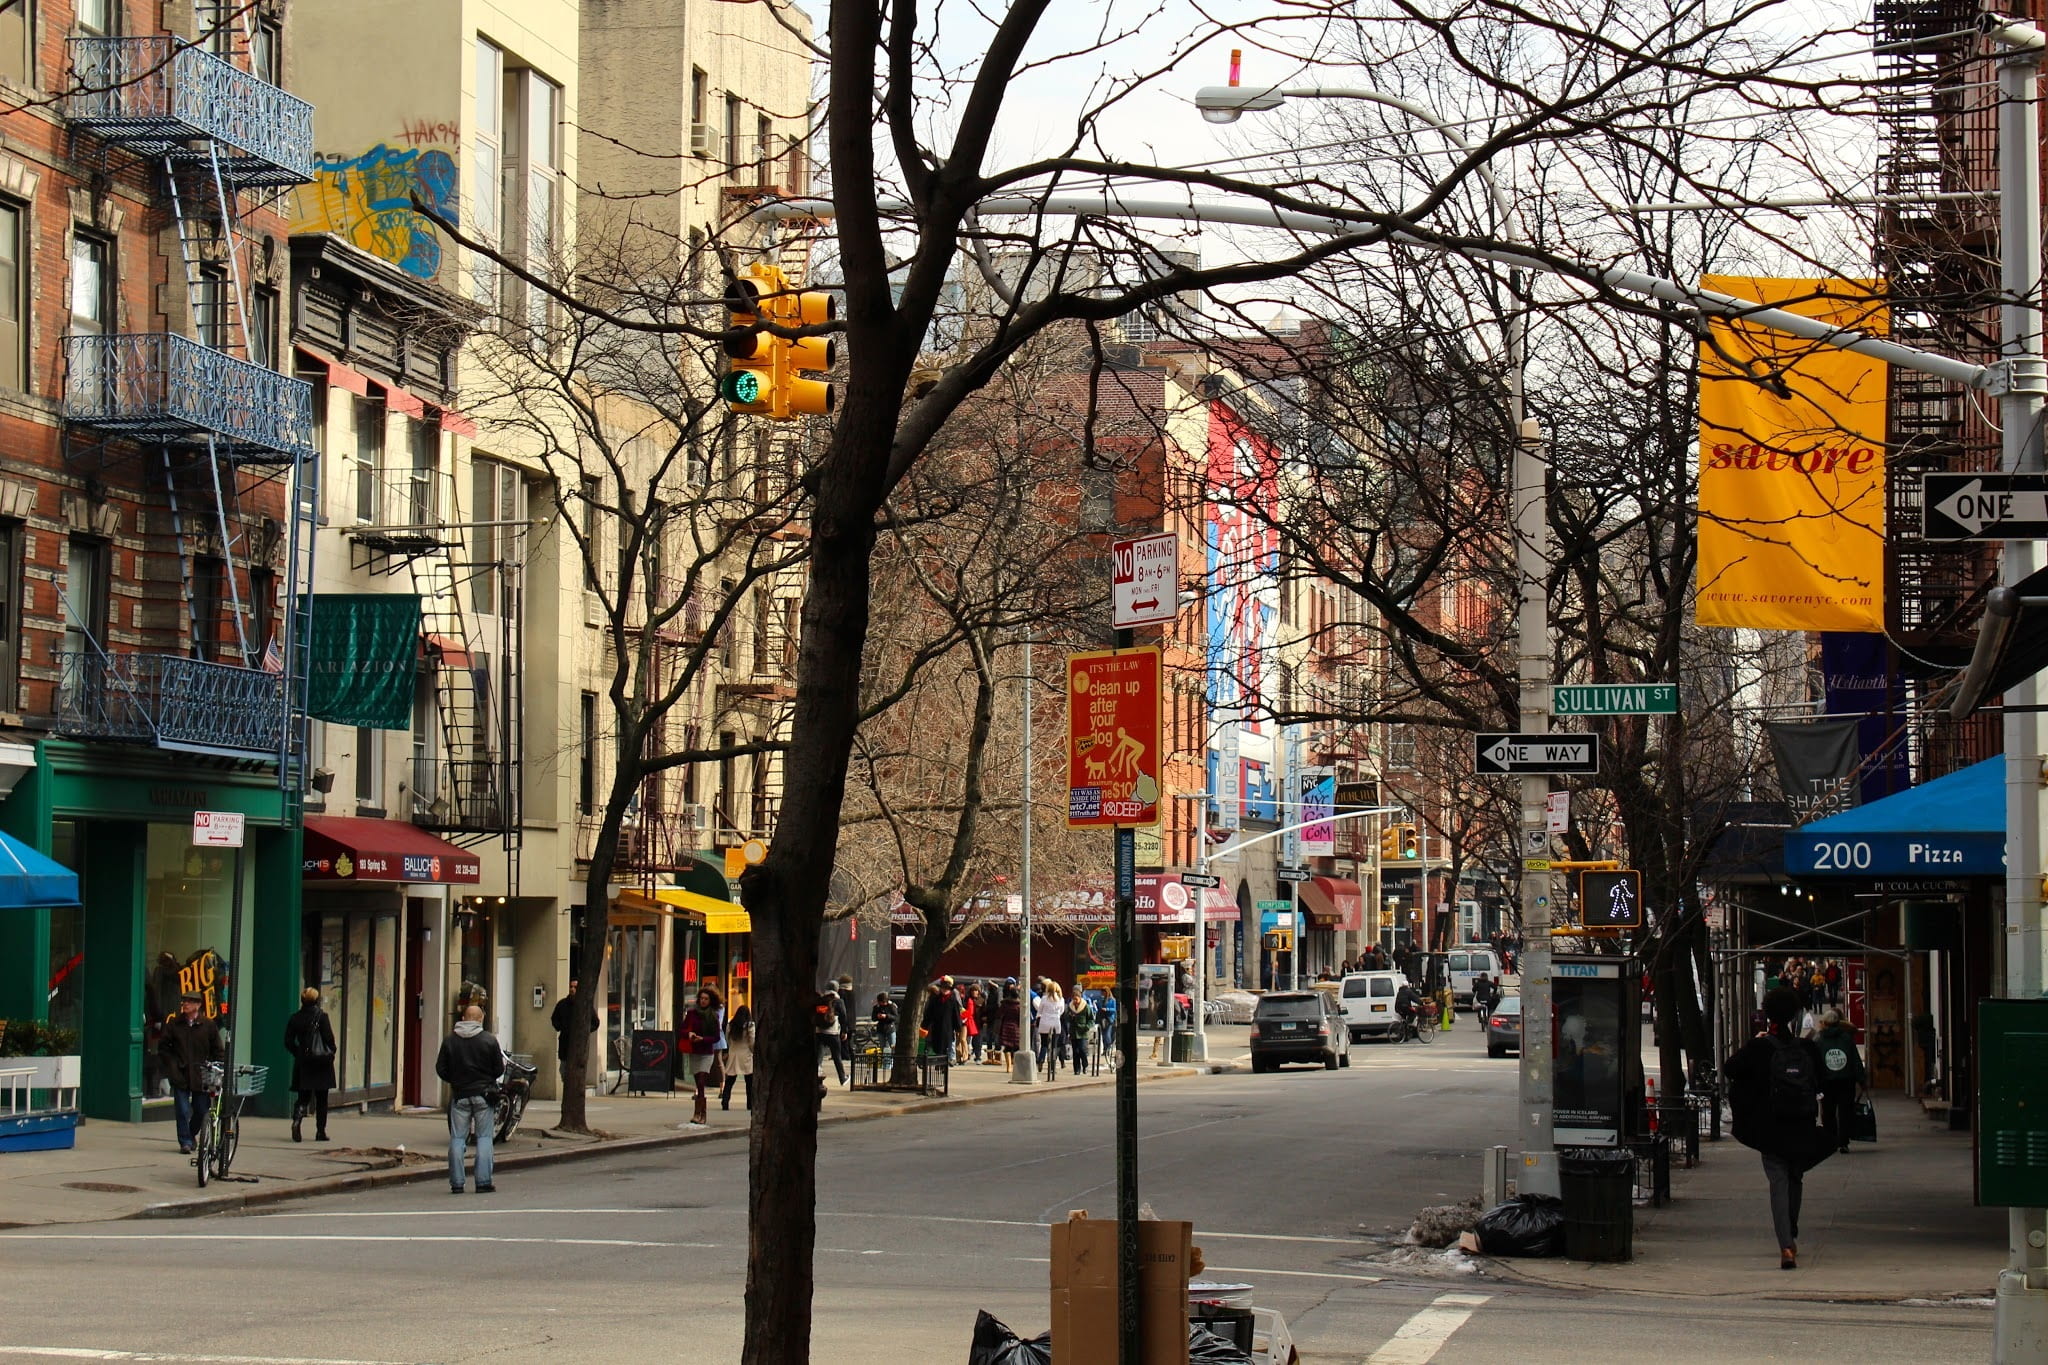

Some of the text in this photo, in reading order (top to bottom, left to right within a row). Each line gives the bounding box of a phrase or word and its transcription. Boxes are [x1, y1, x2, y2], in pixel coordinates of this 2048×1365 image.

[1711, 443, 1874, 475] savore
[1957, 495, 2014, 519] ONE
[1115, 540, 1172, 578] NO PARKING
[1089, 660, 1139, 674] IT'S THE LAW
[1089, 680, 1140, 696] clean up
[1089, 697, 1117, 713] after
[1558, 688, 1670, 712] SULLIVAN ST
[1089, 713, 1116, 731] your
[1090, 729, 1113, 747] dog
[1495, 746, 1582, 761] ONE WAY
[1303, 780, 1319, 790] NYC
[1810, 778, 1850, 792] THE
[1304, 795, 1330, 811] NYC
[1787, 795, 1852, 808] SHADE
[196, 814, 210, 826] NO
[1121, 834, 1132, 846] AS
[1121, 847, 1132, 875] KNOWN
[1813, 842, 1872, 870] 200
[367, 859, 380, 873] Spring
[404, 857, 440, 873] BALUCHI'S
[178, 951, 215, 995] BIG
[1558, 965, 1599, 976] TITAN
